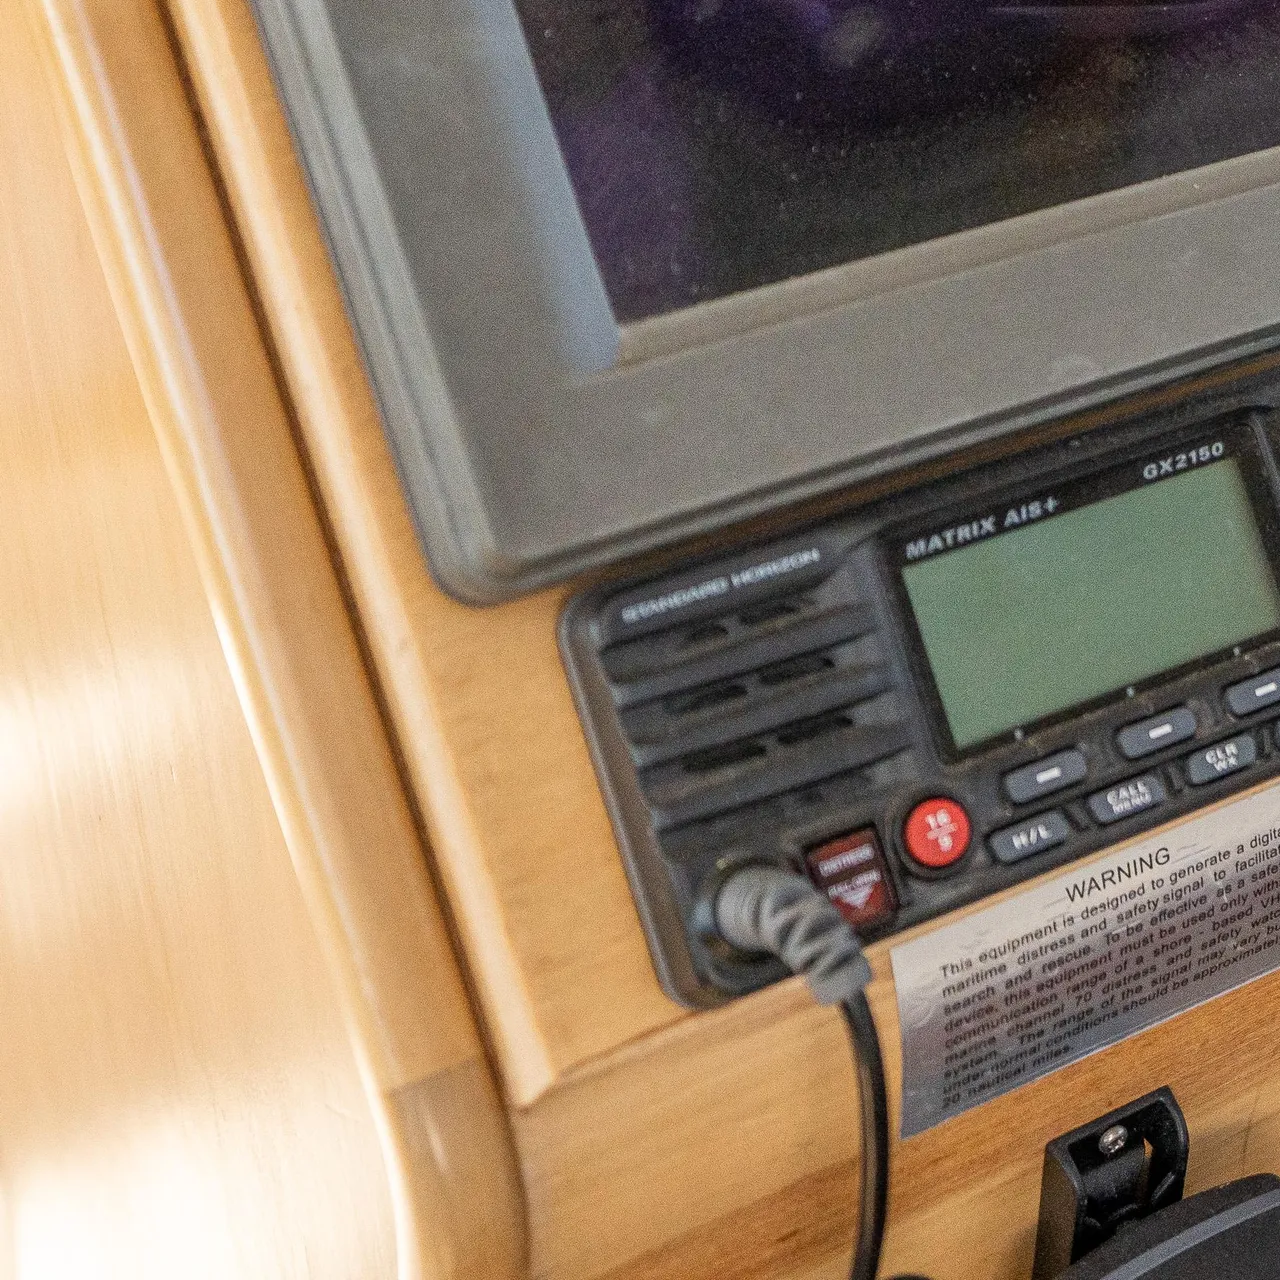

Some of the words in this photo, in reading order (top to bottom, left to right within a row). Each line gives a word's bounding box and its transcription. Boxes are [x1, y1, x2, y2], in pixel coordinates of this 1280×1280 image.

[1142, 441, 1225, 481] GX2150
[905, 518, 995, 560] MATRIX
[1003, 496, 1060, 528] AIS+
[621, 577, 731, 623] STANDARD
[731, 548, 821, 589] HORIZON
[1107, 782, 1147, 805] CALL
[1205, 743, 1237, 764] CLR
[1213, 754, 1238, 772] WX
[940, 958, 973, 978] This
[978, 921, 1058, 964] equipment
[1062, 915, 1075, 929] is
[1080, 883, 1145, 920] designed
[1151, 877, 1165, 890] to
[1169, 850, 1231, 885] generate
[1236, 844, 1245, 854] a
[1065, 847, 1170, 903] WARNING
[942, 963, 1007, 998] maritime
[1017, 934, 1075, 966] distress
[1081, 918, 1107, 939] and
[1117, 896, 1159, 924] safety
[1163, 877, 1204, 903] signal
[1213, 869, 1226, 882] to
[944, 985, 996, 1016] search
[1005, 970, 1032, 990] and
[1104, 931, 1120, 946] To
[1126, 921, 1143, 936] be
[1150, 893, 1207, 925] effective
[1216, 884, 1232, 898] as
[1237, 878, 1245, 889] a
[945, 993, 1058, 1049] communication
[1066, 971, 1107, 997] range
[1115, 960, 1128, 974] of
[1136, 955, 1144, 966] a
[1153, 933, 1192, 958] shore
[1212, 906, 1253, 932] based
[1004, 988, 1031, 1007] this
[1036, 951, 1113, 994] equipment
[1120, 933, 1154, 957] must
[1159, 925, 1176, 939] be
[1182, 907, 1215, 929] used
[1220, 891, 1249, 913] only
[945, 1035, 997, 1065] marine
[1007, 1004, 1065, 1037] channel
[1075, 991, 1092, 1007] 70
[1102, 965, 1157, 995] distress
[1167, 947, 1192, 967] and
[1201, 926, 1242, 953] safety
[1018, 1028, 1045, 1045] The
[1053, 1007, 1094, 1032] range
[1102, 995, 1115, 1009] of
[1121, 985, 1143, 1002] the
[1151, 961, 1192, 989] signal
[1198, 947, 1226, 969] may
[1232, 931, 1261, 952] vary
[943, 1070, 984, 1095] under
[991, 1042, 1041, 1072] normal
[1045, 1009, 1119, 1049] conditions
[1122, 985, 1168, 1013] should
[1172, 978, 1189, 992] be
[968, 1064, 1026, 1097] nautical
